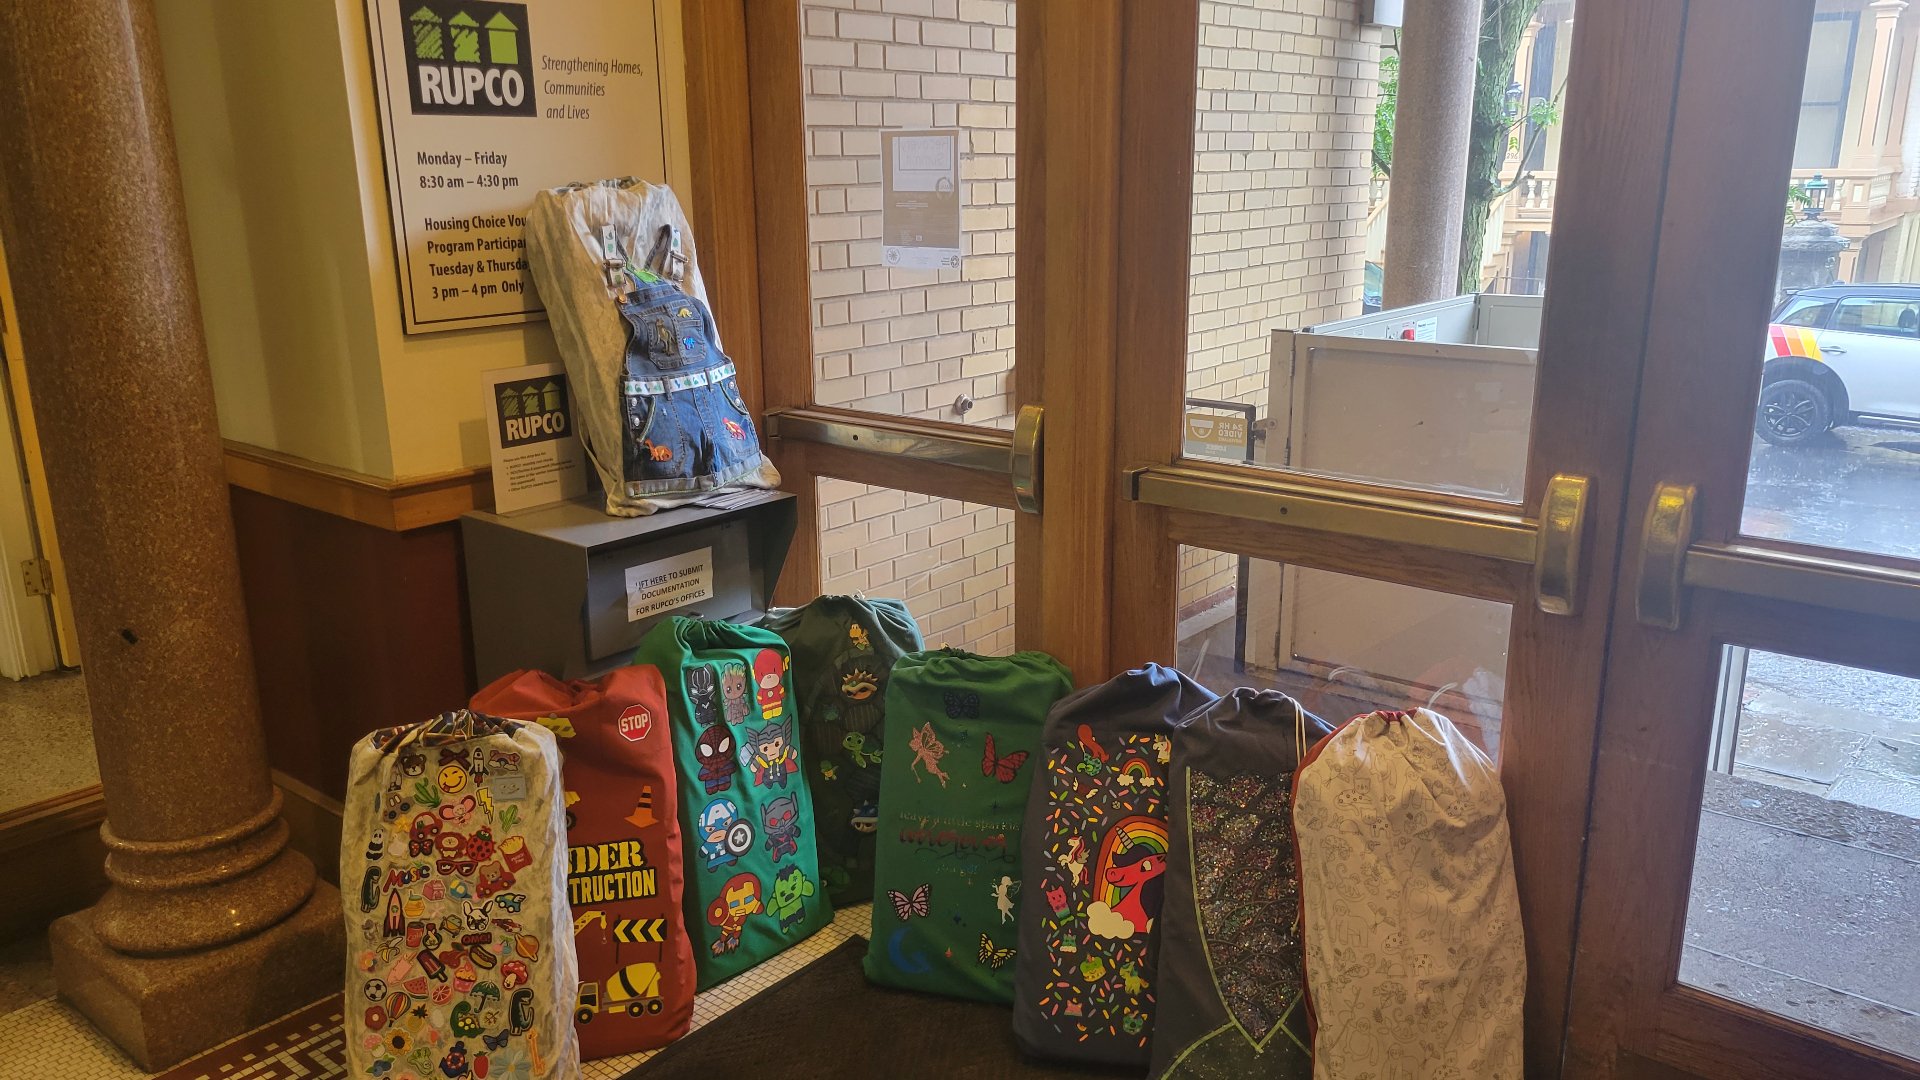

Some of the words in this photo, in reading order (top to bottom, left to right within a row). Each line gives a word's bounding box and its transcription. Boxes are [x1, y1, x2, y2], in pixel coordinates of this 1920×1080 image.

[541, 55, 609, 76] Strengthening
[611, 59, 643, 76] Homes,
[418, 65, 525, 107] RUPCO
[544, 80, 605, 96] Communities
[546, 104, 565, 119] and
[567, 105, 590, 119] Lives
[417, 151, 462, 168] Monday
[474, 151, 507, 168] Friday
[420, 175, 444, 189] 8:30
[447, 177, 464, 188] am
[476, 174, 500, 188] 4:30
[502, 176, 519, 190] pm
[424, 217, 470, 232] Housing
[472, 215, 506, 229] Choice
[427, 240, 475, 256] Program
[429, 261, 474, 277] Tuesday
[477, 260, 485, 273] &
[486, 257, 531, 273] Thursda
[432, 286, 439, 299] 3
[441, 287, 459, 301] pm
[471, 283, 478, 296] 4
[480, 284, 497, 298] pm
[501, 280, 525, 295] Only
[505, 411, 565, 441] RUPCO
[650, 574, 667, 586] HERE
[668, 571, 678, 580] TO
[678, 564, 703, 578] SUBMIT
[641, 578, 700, 601] DOCUMENTATION
[636, 605, 650, 616] FOR
[651, 597, 680, 611] RUPCO'S
[680, 589, 706, 602] OFFICES
[620, 712, 649, 733] STOP
[382, 864, 431, 894] MUSIC
[569, 868, 656, 904] TRUCTION
[463, 933, 491, 944] OMG!
